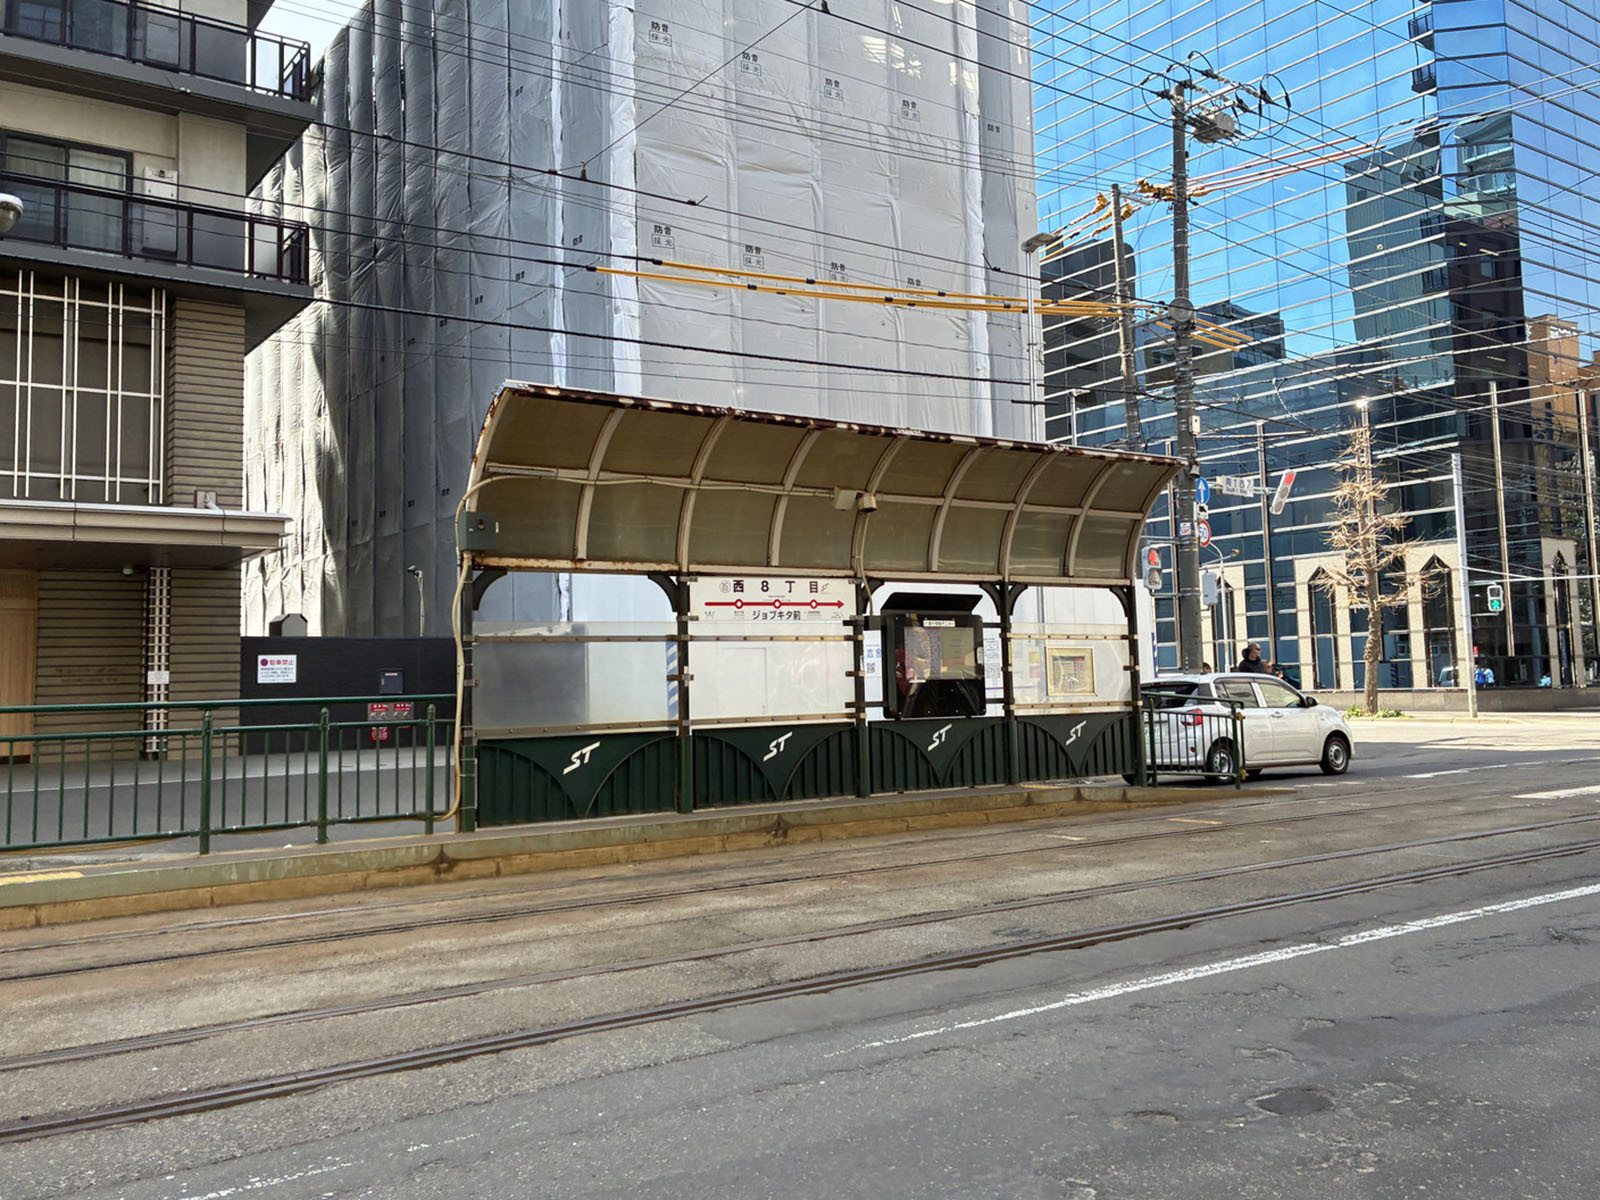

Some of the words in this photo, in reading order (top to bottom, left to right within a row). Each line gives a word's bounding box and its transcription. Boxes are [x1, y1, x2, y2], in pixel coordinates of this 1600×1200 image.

[733, 580, 818, 594] 西8丁目
[752, 610, 801, 621] ジョブキタ前
[763, 731, 793, 762] ST
[927, 723, 953, 752] ST
[1065, 720, 1087, 746] ST
[563, 741, 601, 775] ST
